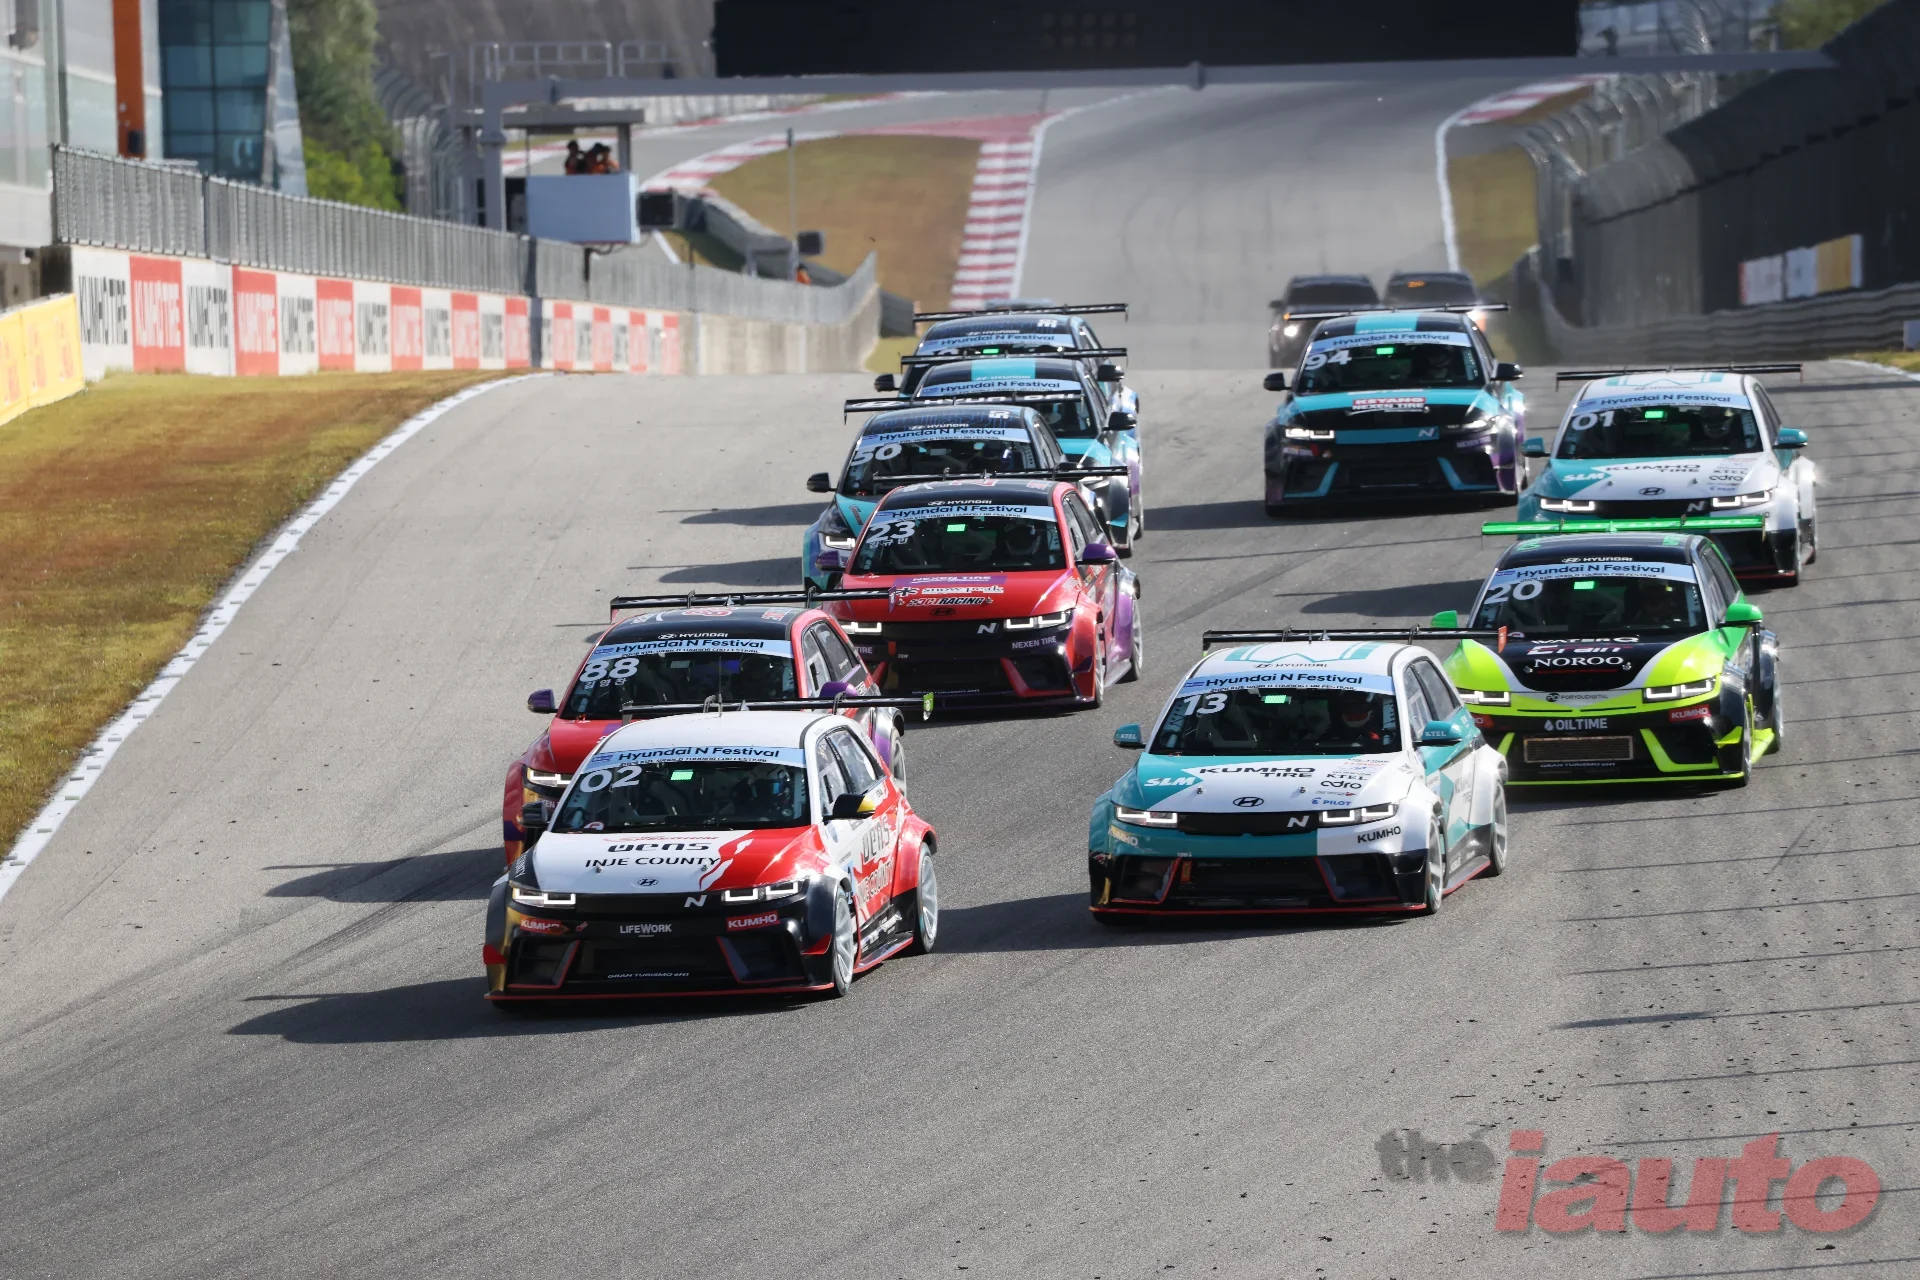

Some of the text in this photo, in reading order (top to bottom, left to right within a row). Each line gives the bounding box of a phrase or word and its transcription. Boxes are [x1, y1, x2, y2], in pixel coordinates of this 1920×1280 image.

[941, 335, 992, 345] Hyundai
[1333, 335, 1385, 346] Hyundai
[1401, 333, 1450, 341] Festival
[1305, 350, 1352, 370] 94
[940, 381, 995, 393] Hyundai
[1601, 393, 1659, 405] Hyundai
[1677, 393, 1731, 402] Festival
[1571, 411, 1615, 430] 01
[879, 429, 936, 441] Hyundai
[1418, 428, 1434, 438] N
[850, 443, 903, 466] 50
[1562, 473, 1605, 482] SLM
[892, 505, 954, 518] Hyundai
[971, 505, 1027, 513] Festival
[1687, 501, 1704, 513] N
[866, 521, 915, 544] 23
[1517, 565, 1584, 578] Hyundai
[1604, 565, 1665, 573] Festival
[1484, 579, 1543, 604] 20
[977, 622, 997, 634] N
[616, 639, 764, 653] Hyundai N Festival
[1012, 636, 1057, 649] NEXEN TIRE
[1534, 656, 1624, 668] NOROO
[579, 657, 640, 683] 88
[1206, 674, 1277, 686] Hyundai
[1297, 674, 1362, 684] Festival
[1182, 692, 1229, 716] 13
[1671, 707, 1709, 720] KUMHO
[1555, 718, 1608, 731] OILTIME
[618, 747, 779, 761] Hyundai N Festival
[580, 765, 642, 793] 02
[1144, 776, 1195, 787] SLM
[1326, 773, 1368, 781] KTEL
[1322, 799, 1352, 807] PILOT
[1287, 815, 1310, 828] N
[1357, 826, 1402, 844] KUMHO
[585, 857, 722, 867] INJE COUNTY
[684, 894, 708, 908] N
[728, 913, 778, 930] KUMHO
[619, 923, 673, 934] LIFEWORK
